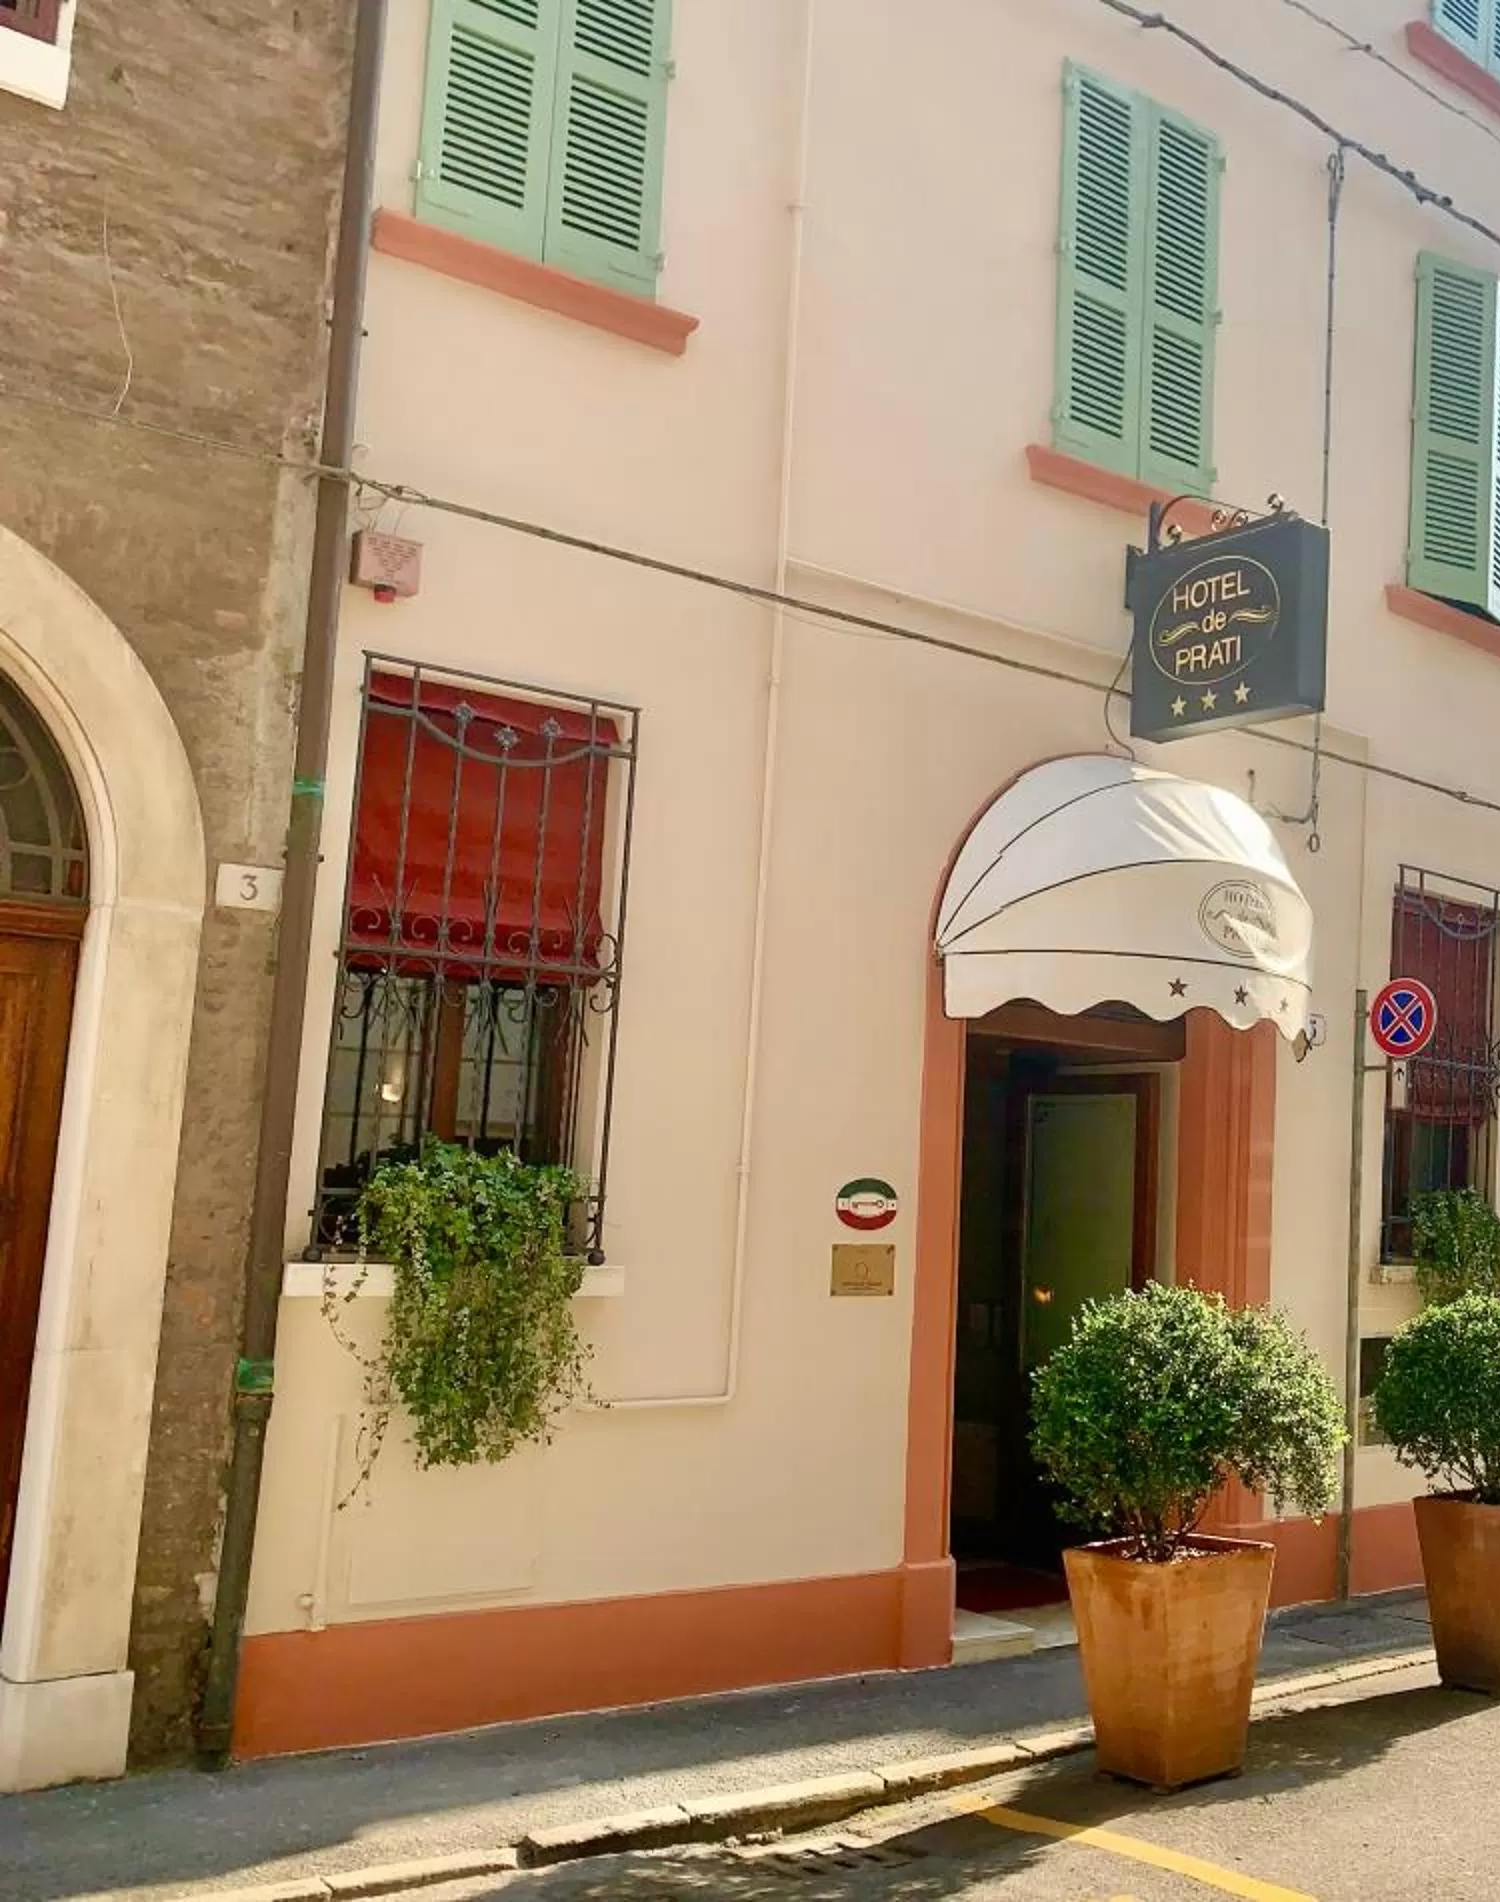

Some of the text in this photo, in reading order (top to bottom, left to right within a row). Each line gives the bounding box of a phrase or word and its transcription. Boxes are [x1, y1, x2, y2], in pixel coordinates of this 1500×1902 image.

[1172, 569, 1251, 614] HOTEL
[1201, 608, 1228, 634] de
[1174, 635, 1242, 676] PRATI
[240, 874, 258, 901] 3
